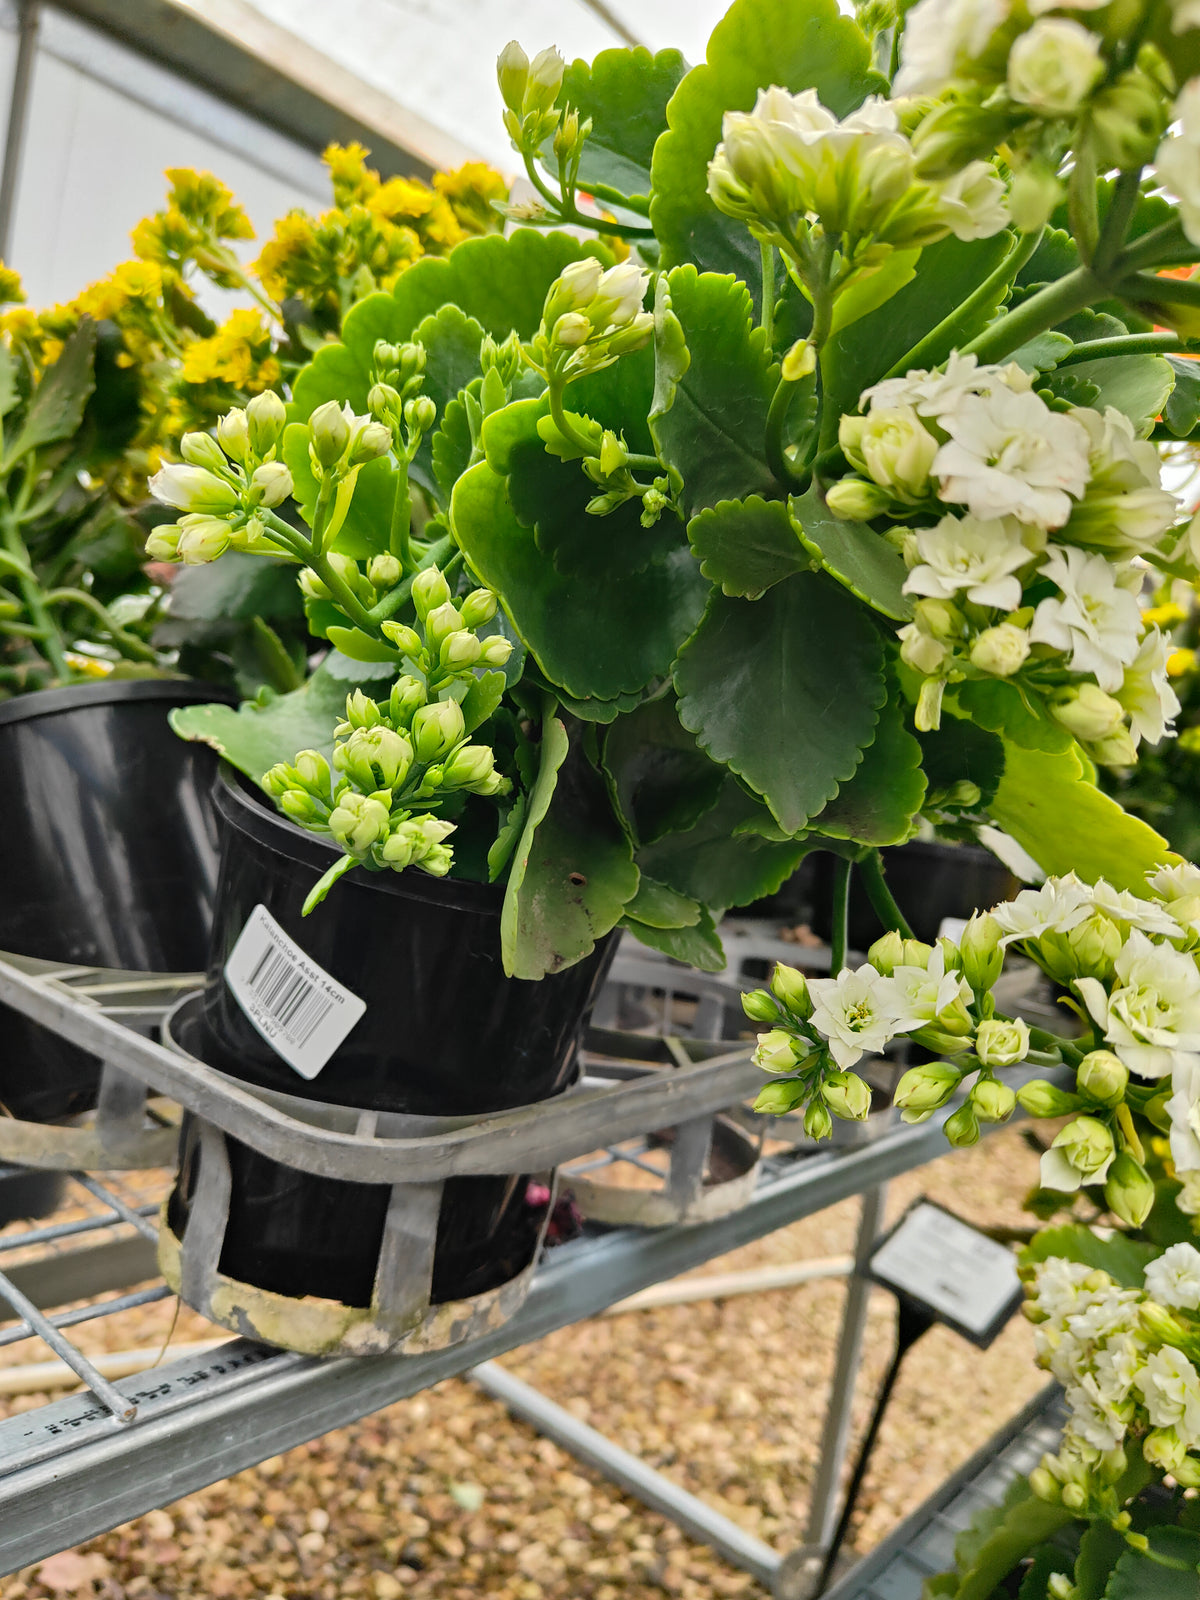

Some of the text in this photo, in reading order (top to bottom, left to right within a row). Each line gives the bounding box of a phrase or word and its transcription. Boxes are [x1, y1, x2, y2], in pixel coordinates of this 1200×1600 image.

[259, 914, 298, 961] Kalanchoe
[297, 961, 320, 983] Asst
[320, 980, 346, 1005] 14cm
